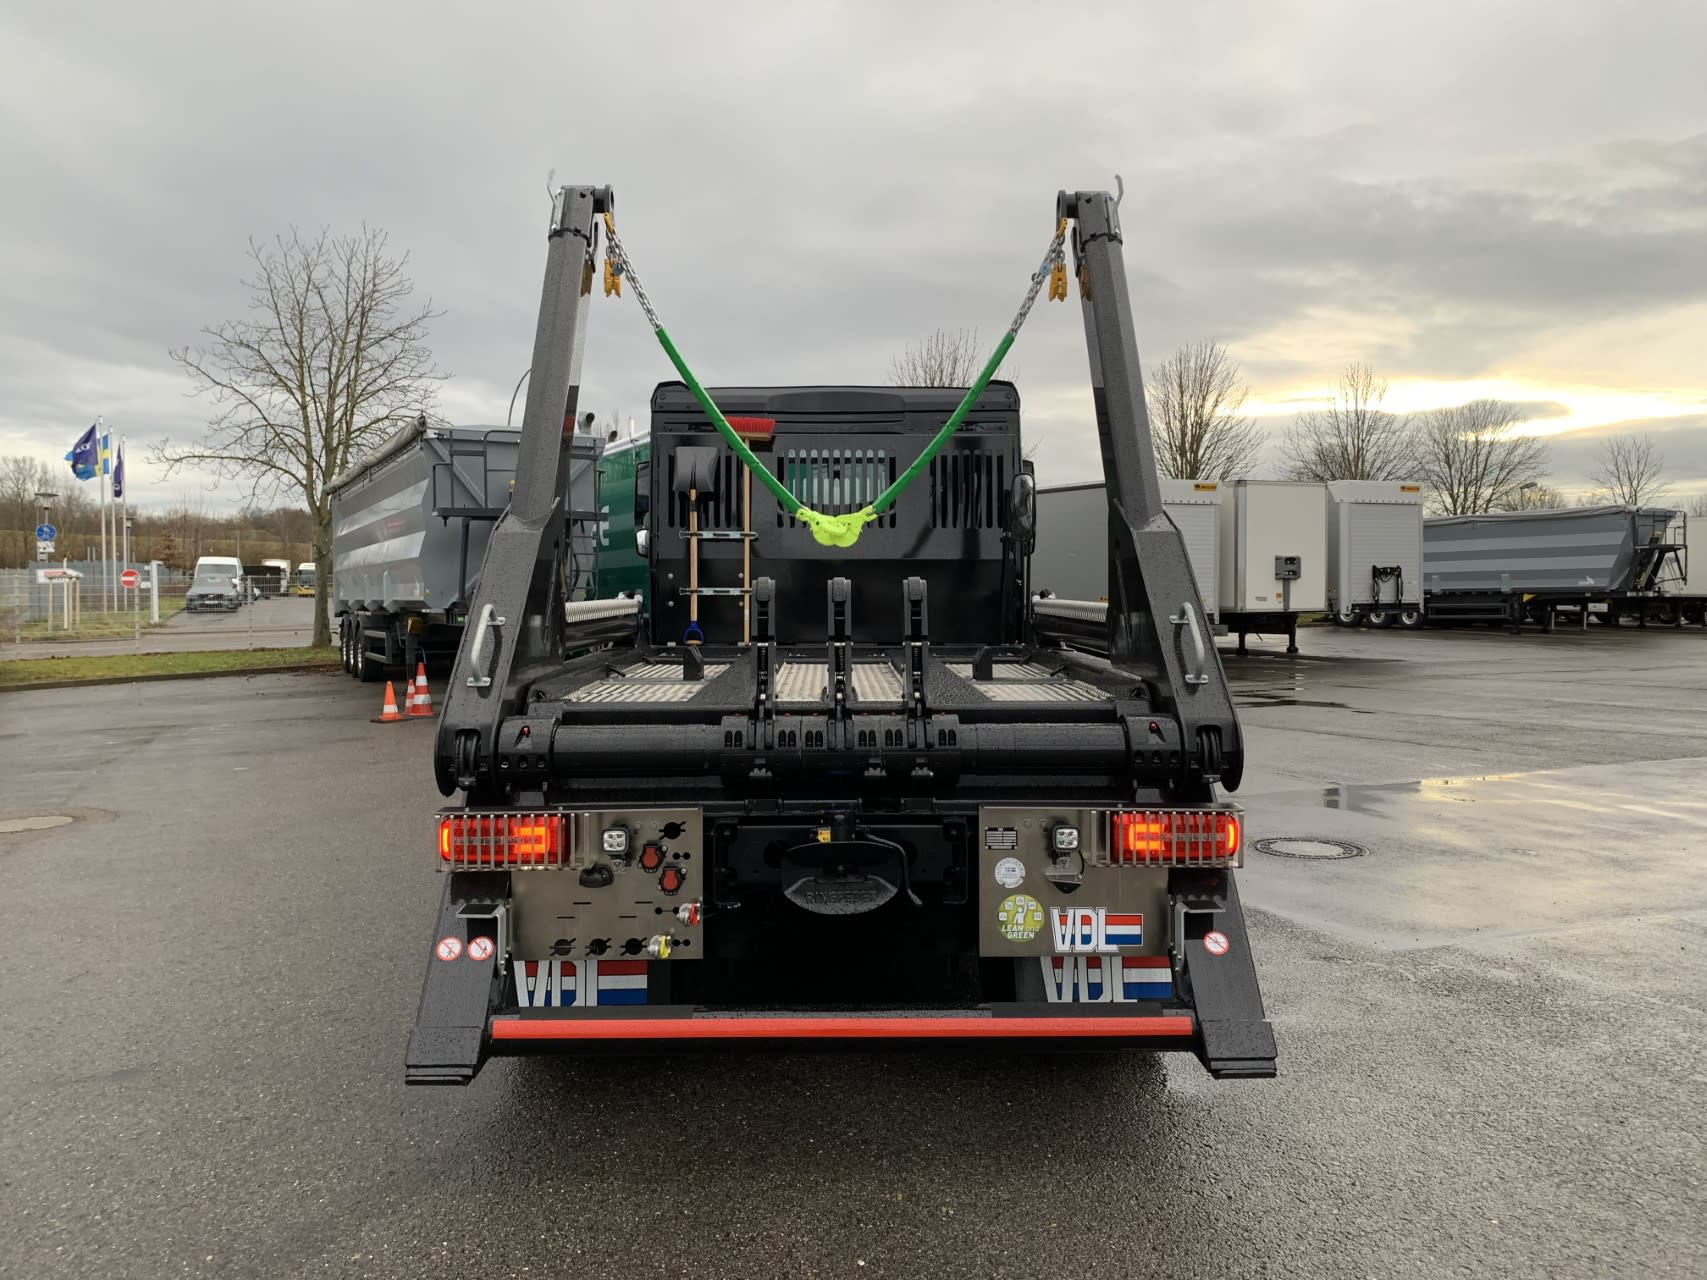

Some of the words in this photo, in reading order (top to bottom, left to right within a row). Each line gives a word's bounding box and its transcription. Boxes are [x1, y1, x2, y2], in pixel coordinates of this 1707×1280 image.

[1001, 924, 1024, 932] LEAN
[1050, 907, 1119, 952] VDL
[1007, 931, 1035, 939] GREEN
